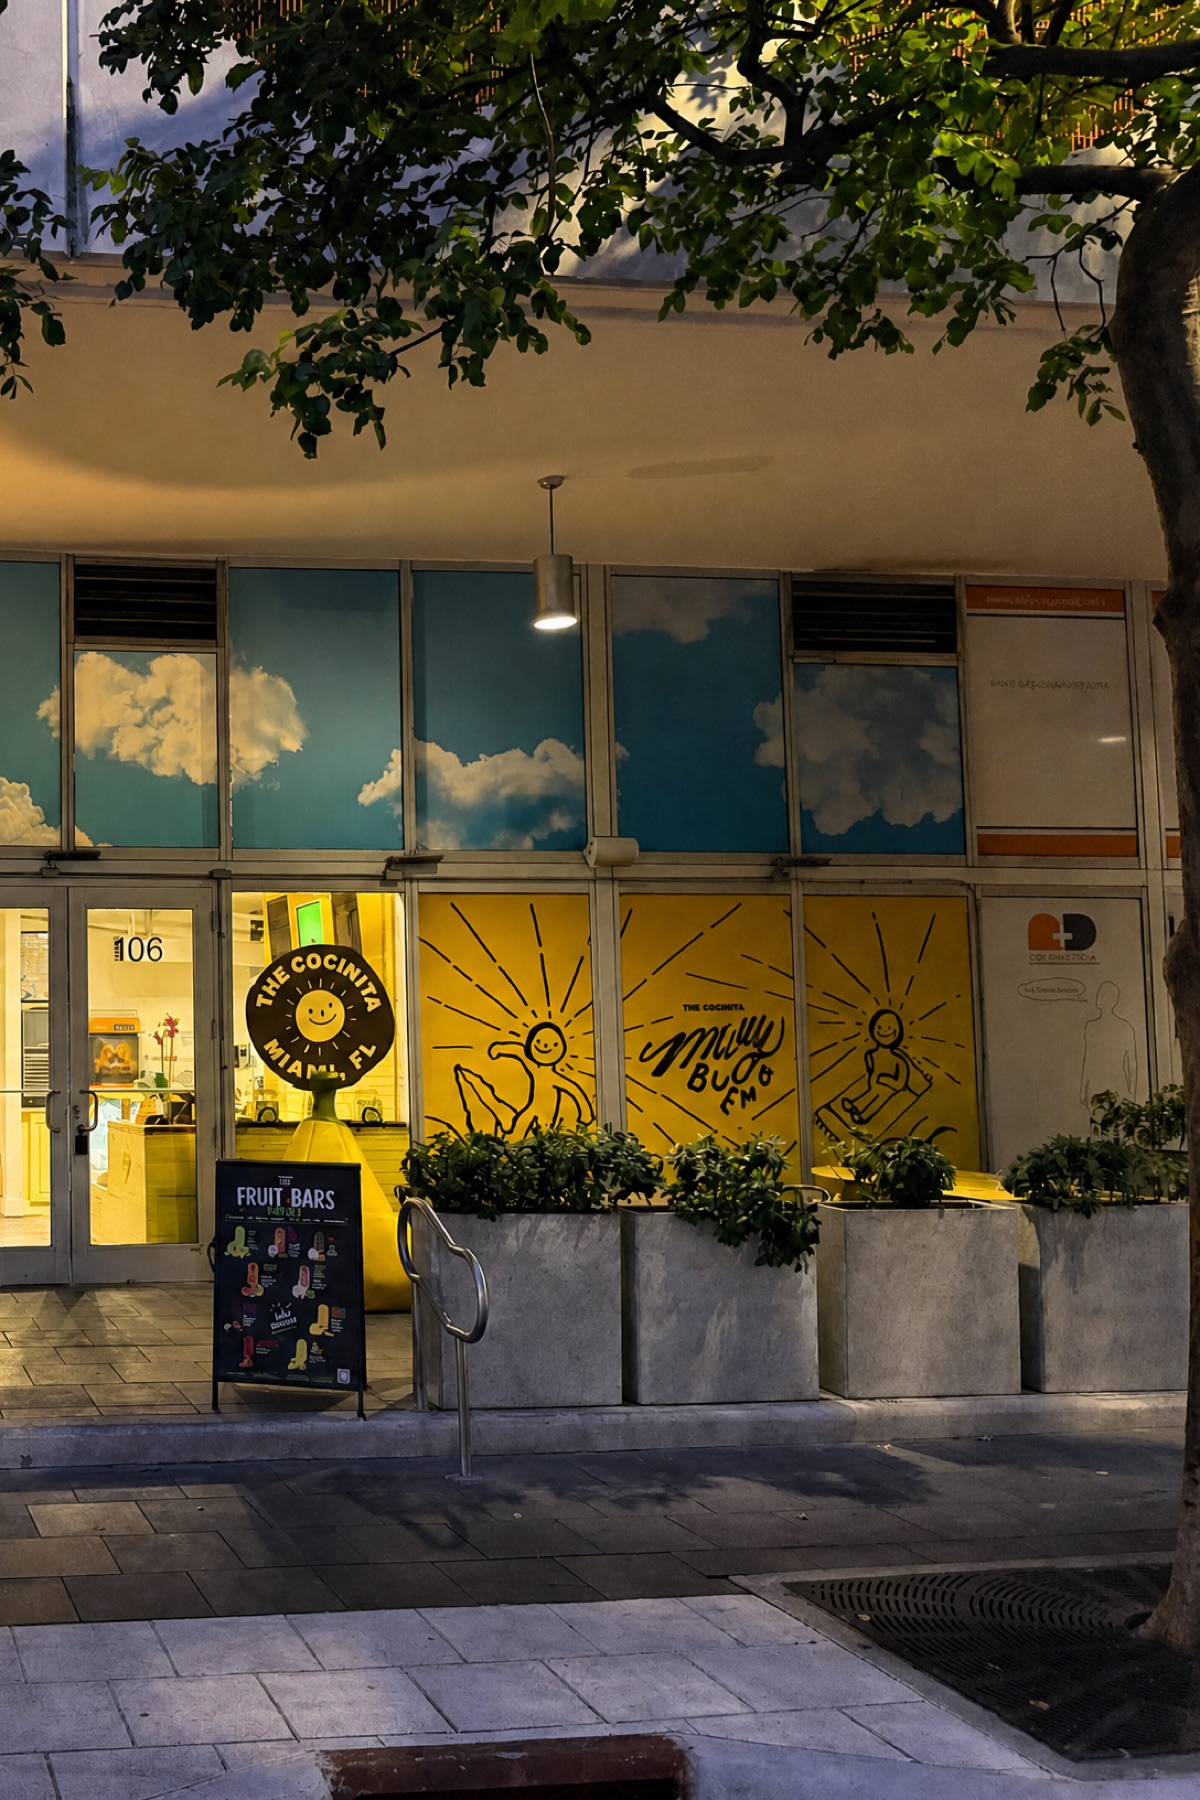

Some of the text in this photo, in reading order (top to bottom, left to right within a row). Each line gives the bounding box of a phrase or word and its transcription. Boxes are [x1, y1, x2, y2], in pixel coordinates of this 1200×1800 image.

[115, 936, 163, 962] 106
[256, 953, 382, 1012] THE COCINITA
[683, 1003, 701, 1012] THE
[349, 1043, 377, 1070] FL
[237, 1186, 336, 1210] FRUIT BARS
